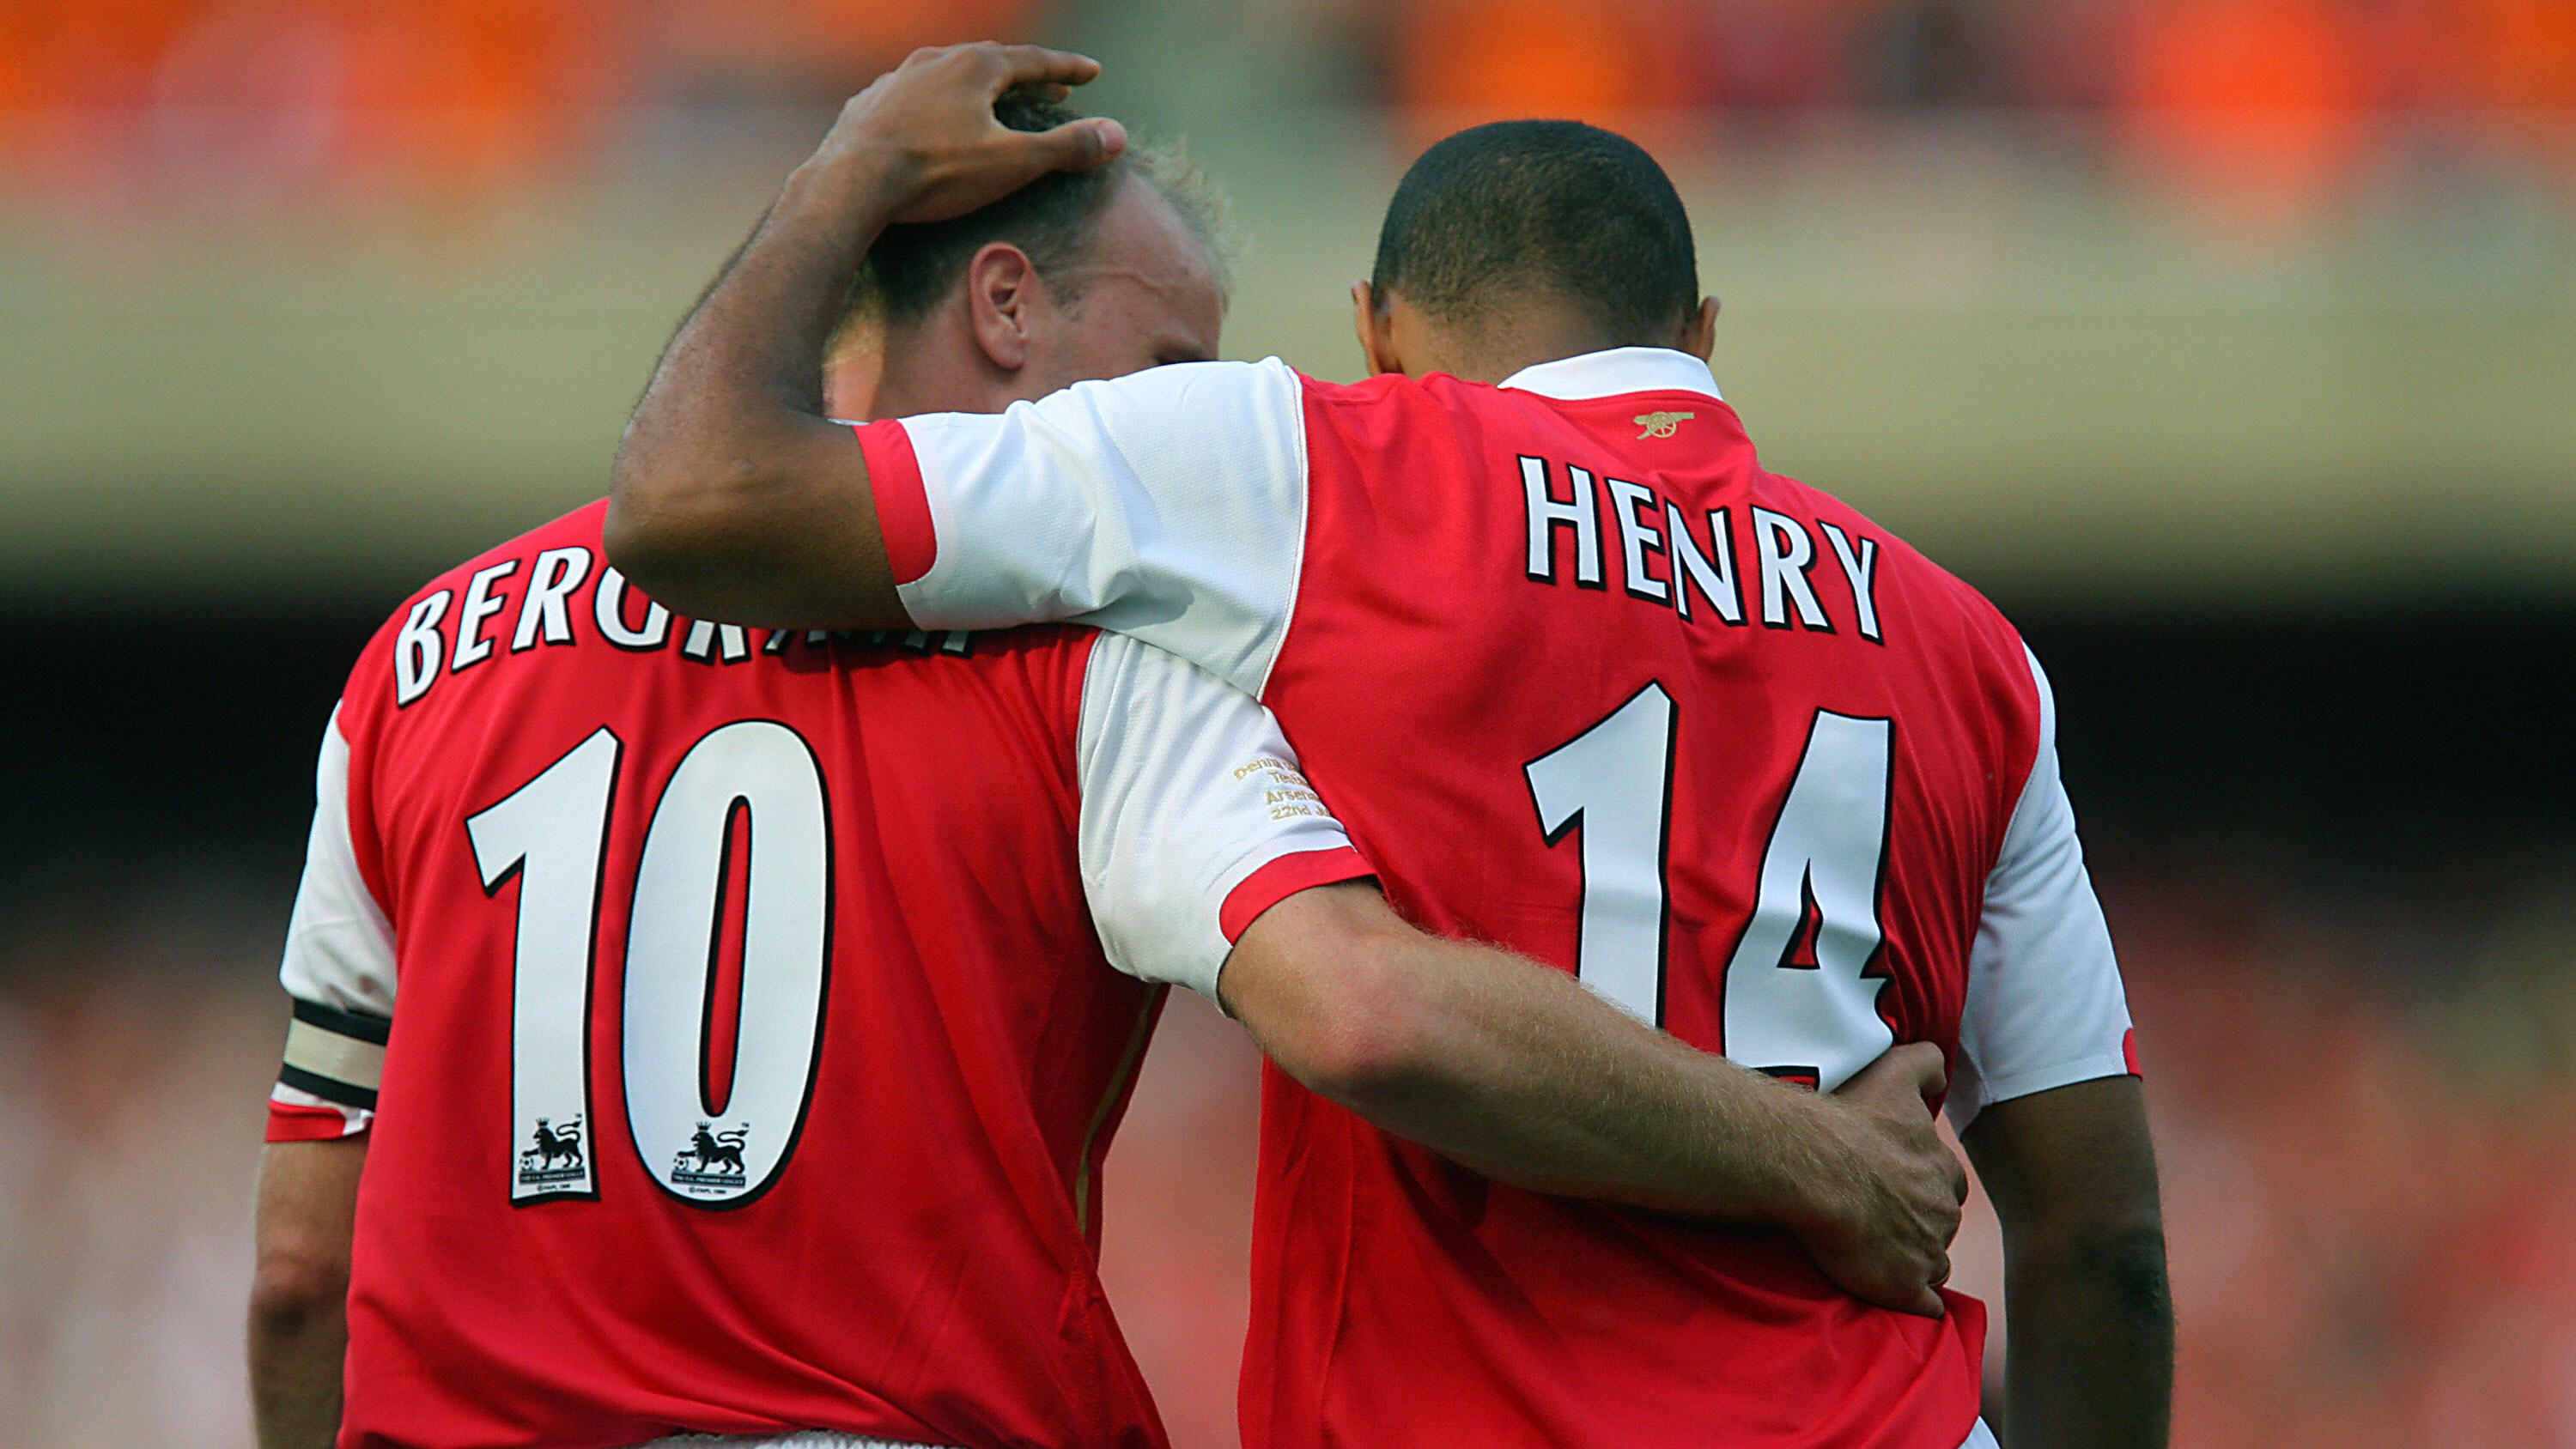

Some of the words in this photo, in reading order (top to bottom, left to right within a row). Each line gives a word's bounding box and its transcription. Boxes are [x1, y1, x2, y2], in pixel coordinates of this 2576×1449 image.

[393, 544, 975, 709] BERG
[1517, 453, 1885, 646] HENRY
[1266, 789, 1321, 804] Arsena
[1272, 803, 1312, 820] 22nd
[1522, 677, 1897, 1094] 14
[465, 718, 835, 1211] 10
